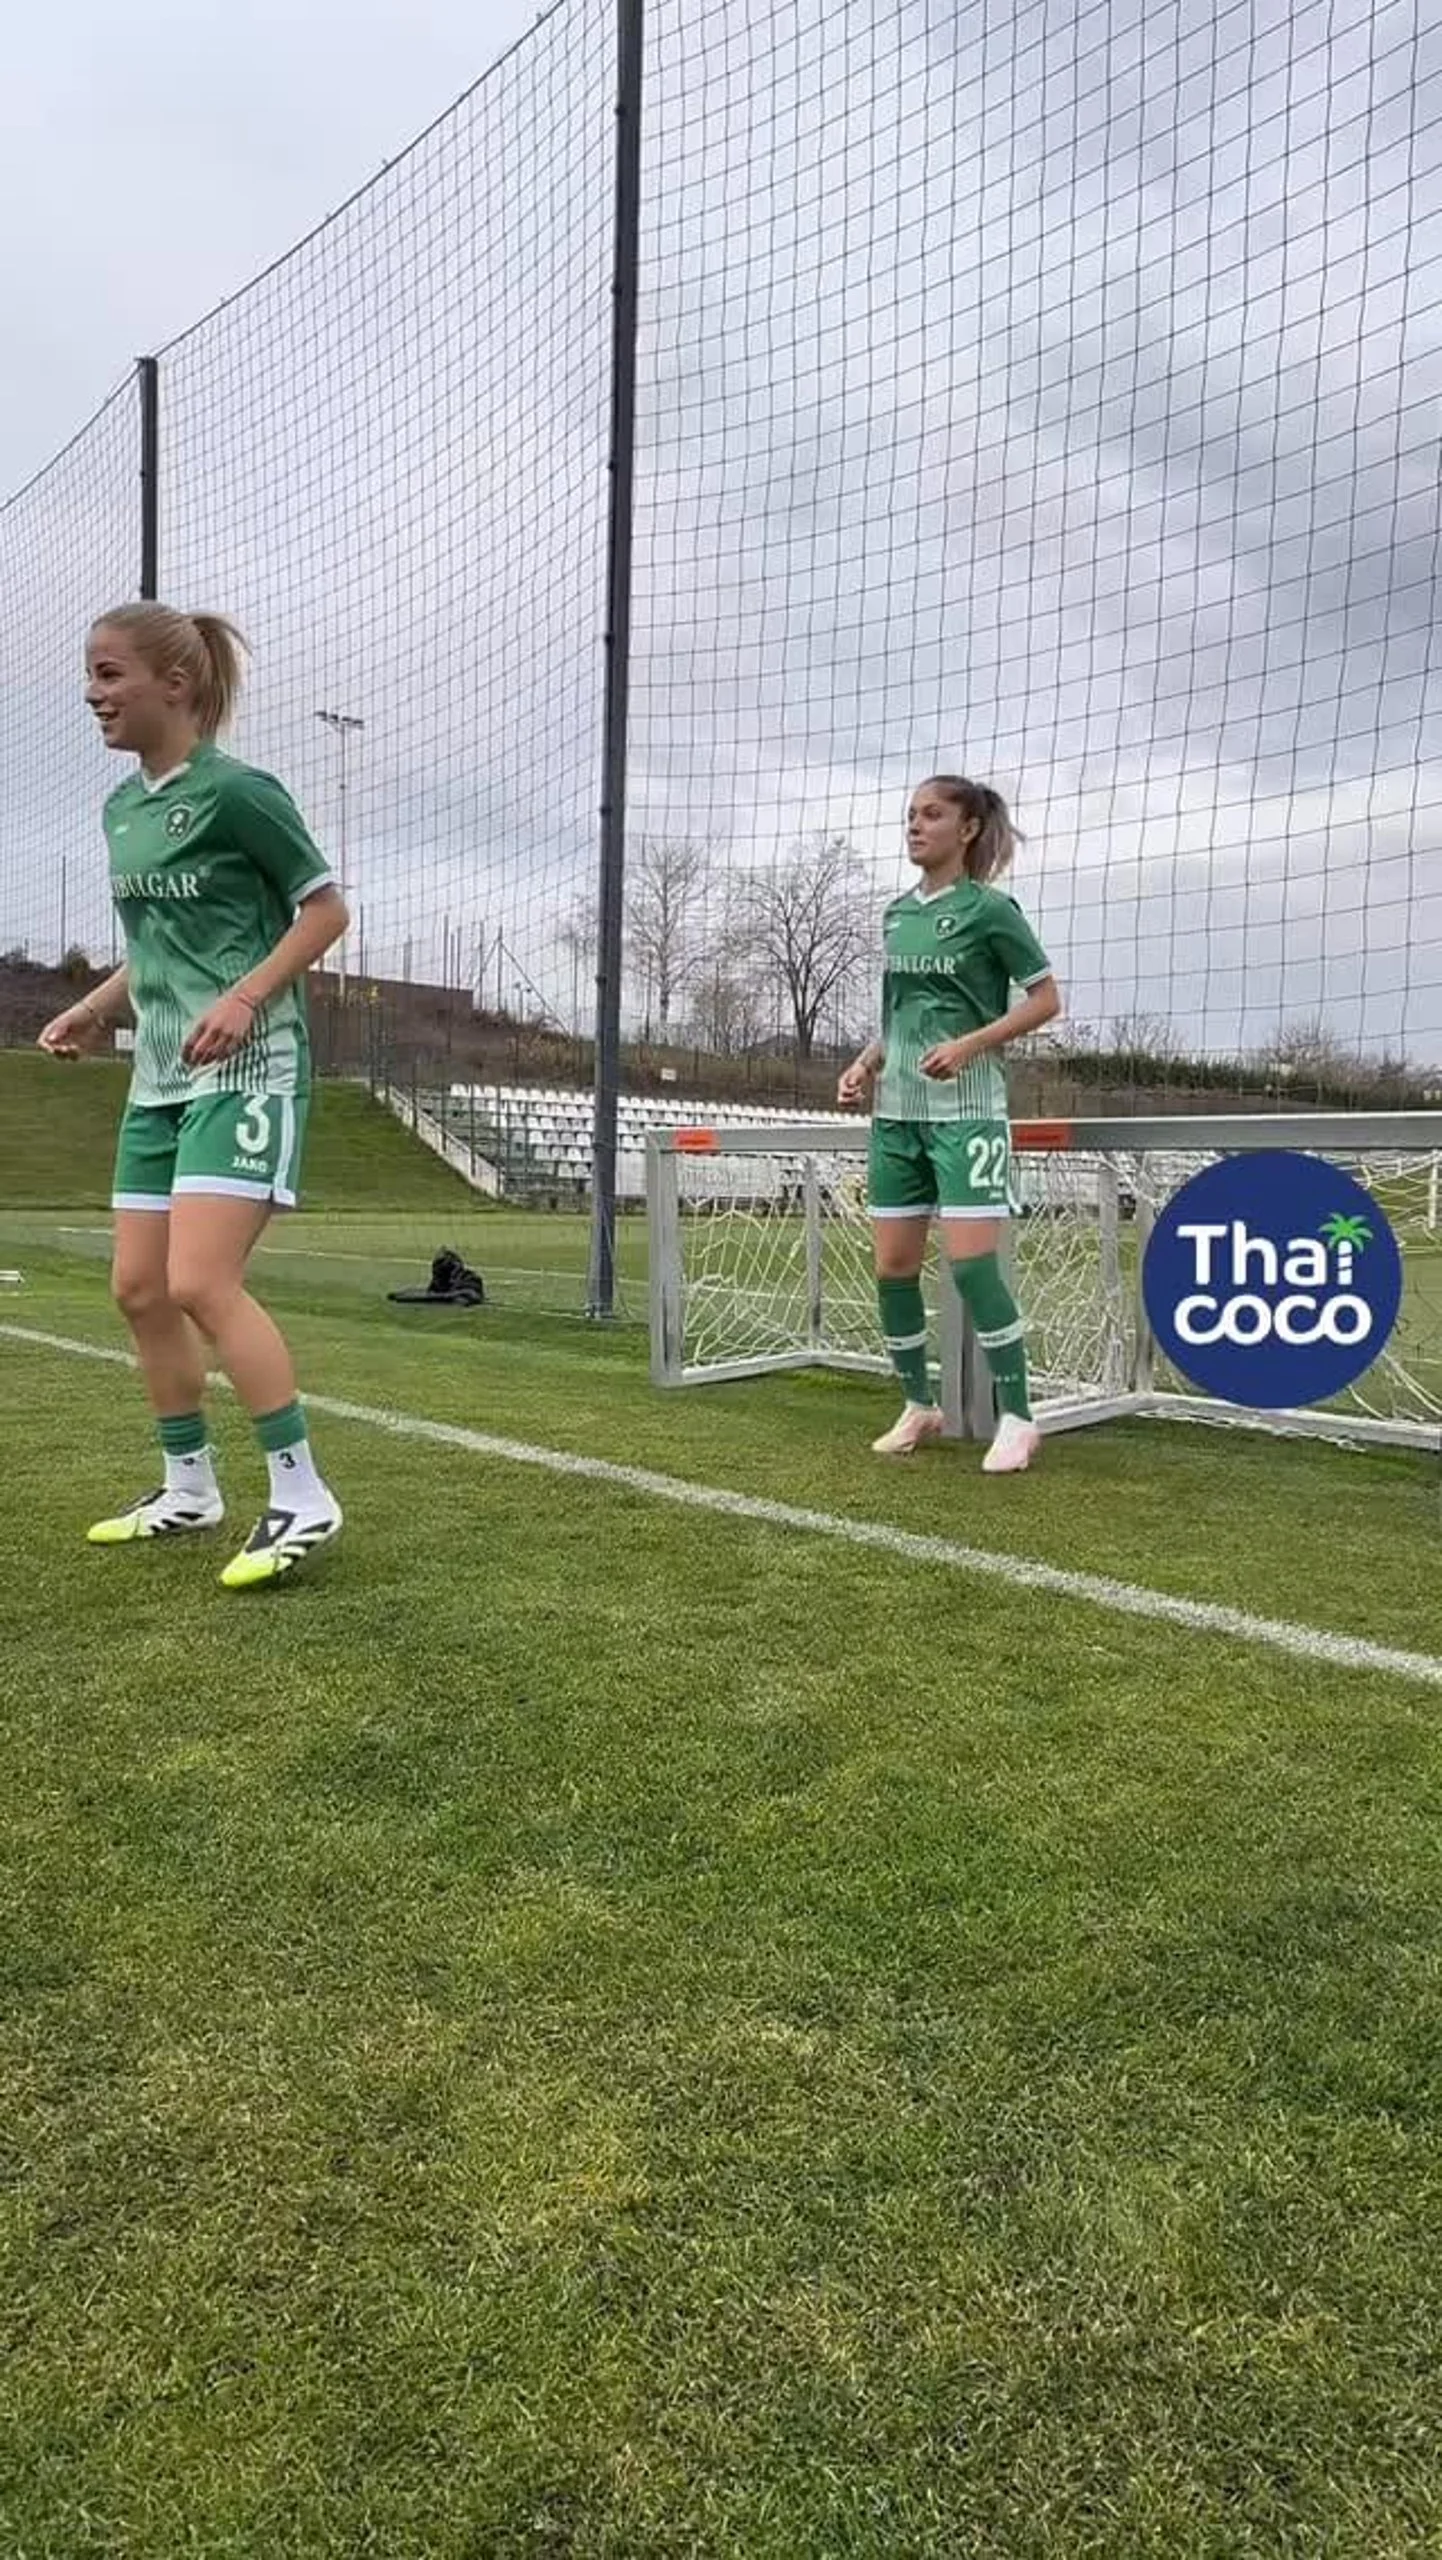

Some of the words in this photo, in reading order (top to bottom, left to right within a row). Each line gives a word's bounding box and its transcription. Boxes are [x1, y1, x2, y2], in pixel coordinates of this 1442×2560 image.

[236, 1094, 270, 1152] 3
[967, 1137, 1006, 1189] 22
[279, 1452, 296, 1469] 3
